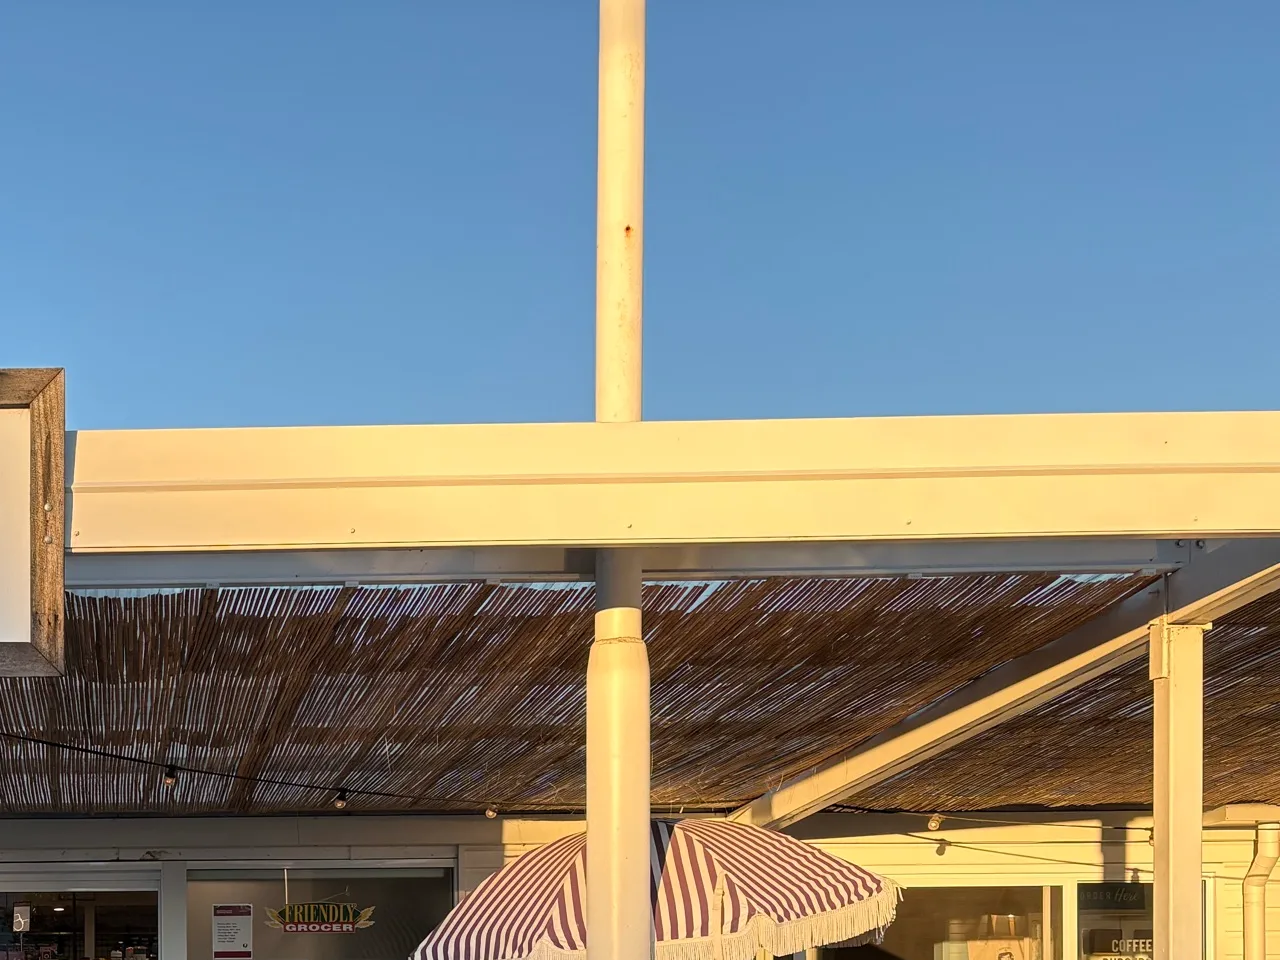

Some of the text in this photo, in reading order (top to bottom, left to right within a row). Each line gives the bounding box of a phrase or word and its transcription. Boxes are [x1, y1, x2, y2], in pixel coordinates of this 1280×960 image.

[285, 904, 354, 922] FRIENDLY
[285, 923, 354, 932] GROCER
[1111, 939, 1153, 952] COFFEE
